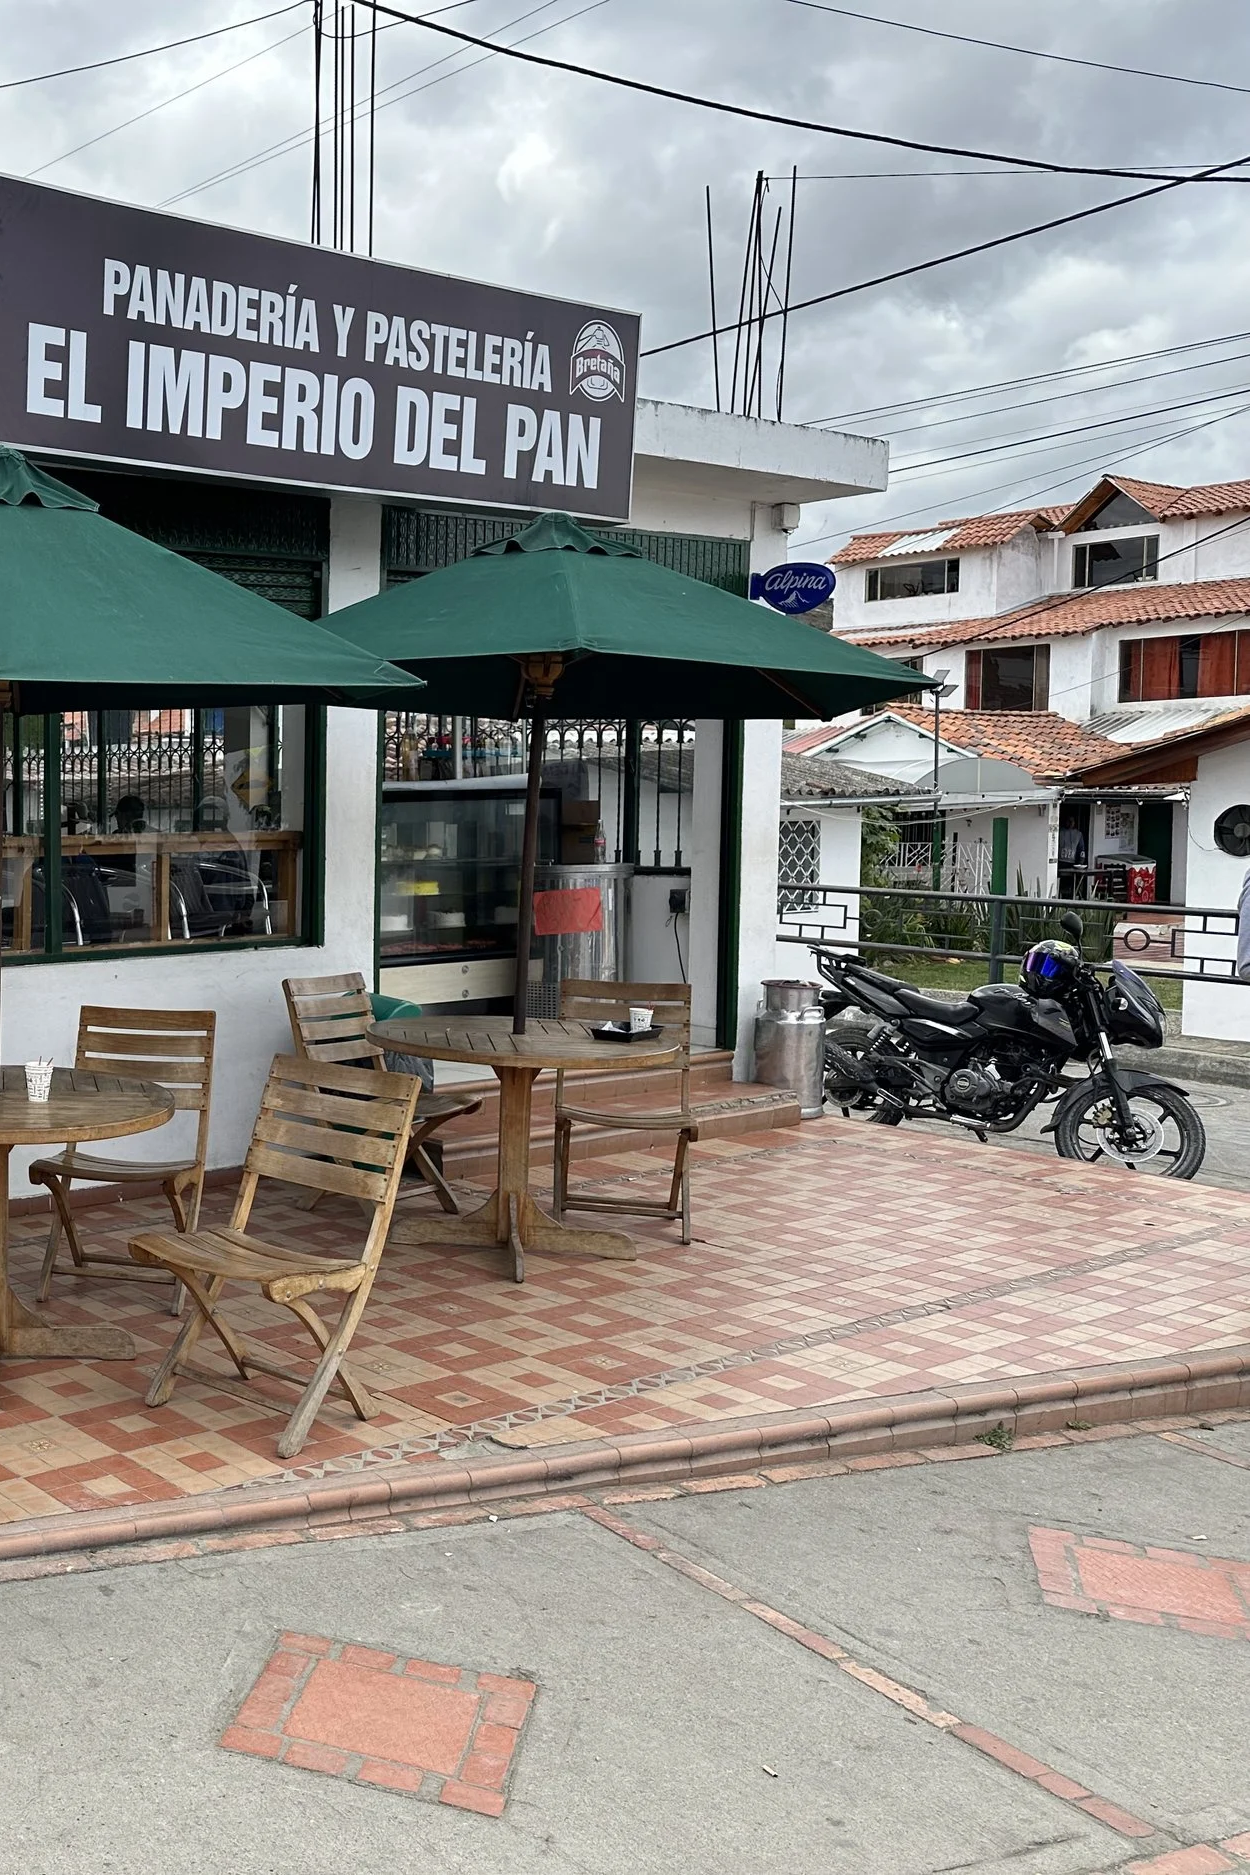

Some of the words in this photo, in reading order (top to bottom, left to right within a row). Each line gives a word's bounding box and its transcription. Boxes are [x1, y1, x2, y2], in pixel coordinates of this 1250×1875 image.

[103, 258, 320, 353] PANADERÍA
[332, 303, 356, 358] Y
[364, 310, 553, 393] PASTELERÍA
[575, 354, 621, 385] Bretaña
[26, 322, 102, 424] EL
[126, 340, 375, 460] IMPERIO
[393, 385, 487, 476] DEL
[503, 403, 602, 490] PAN
